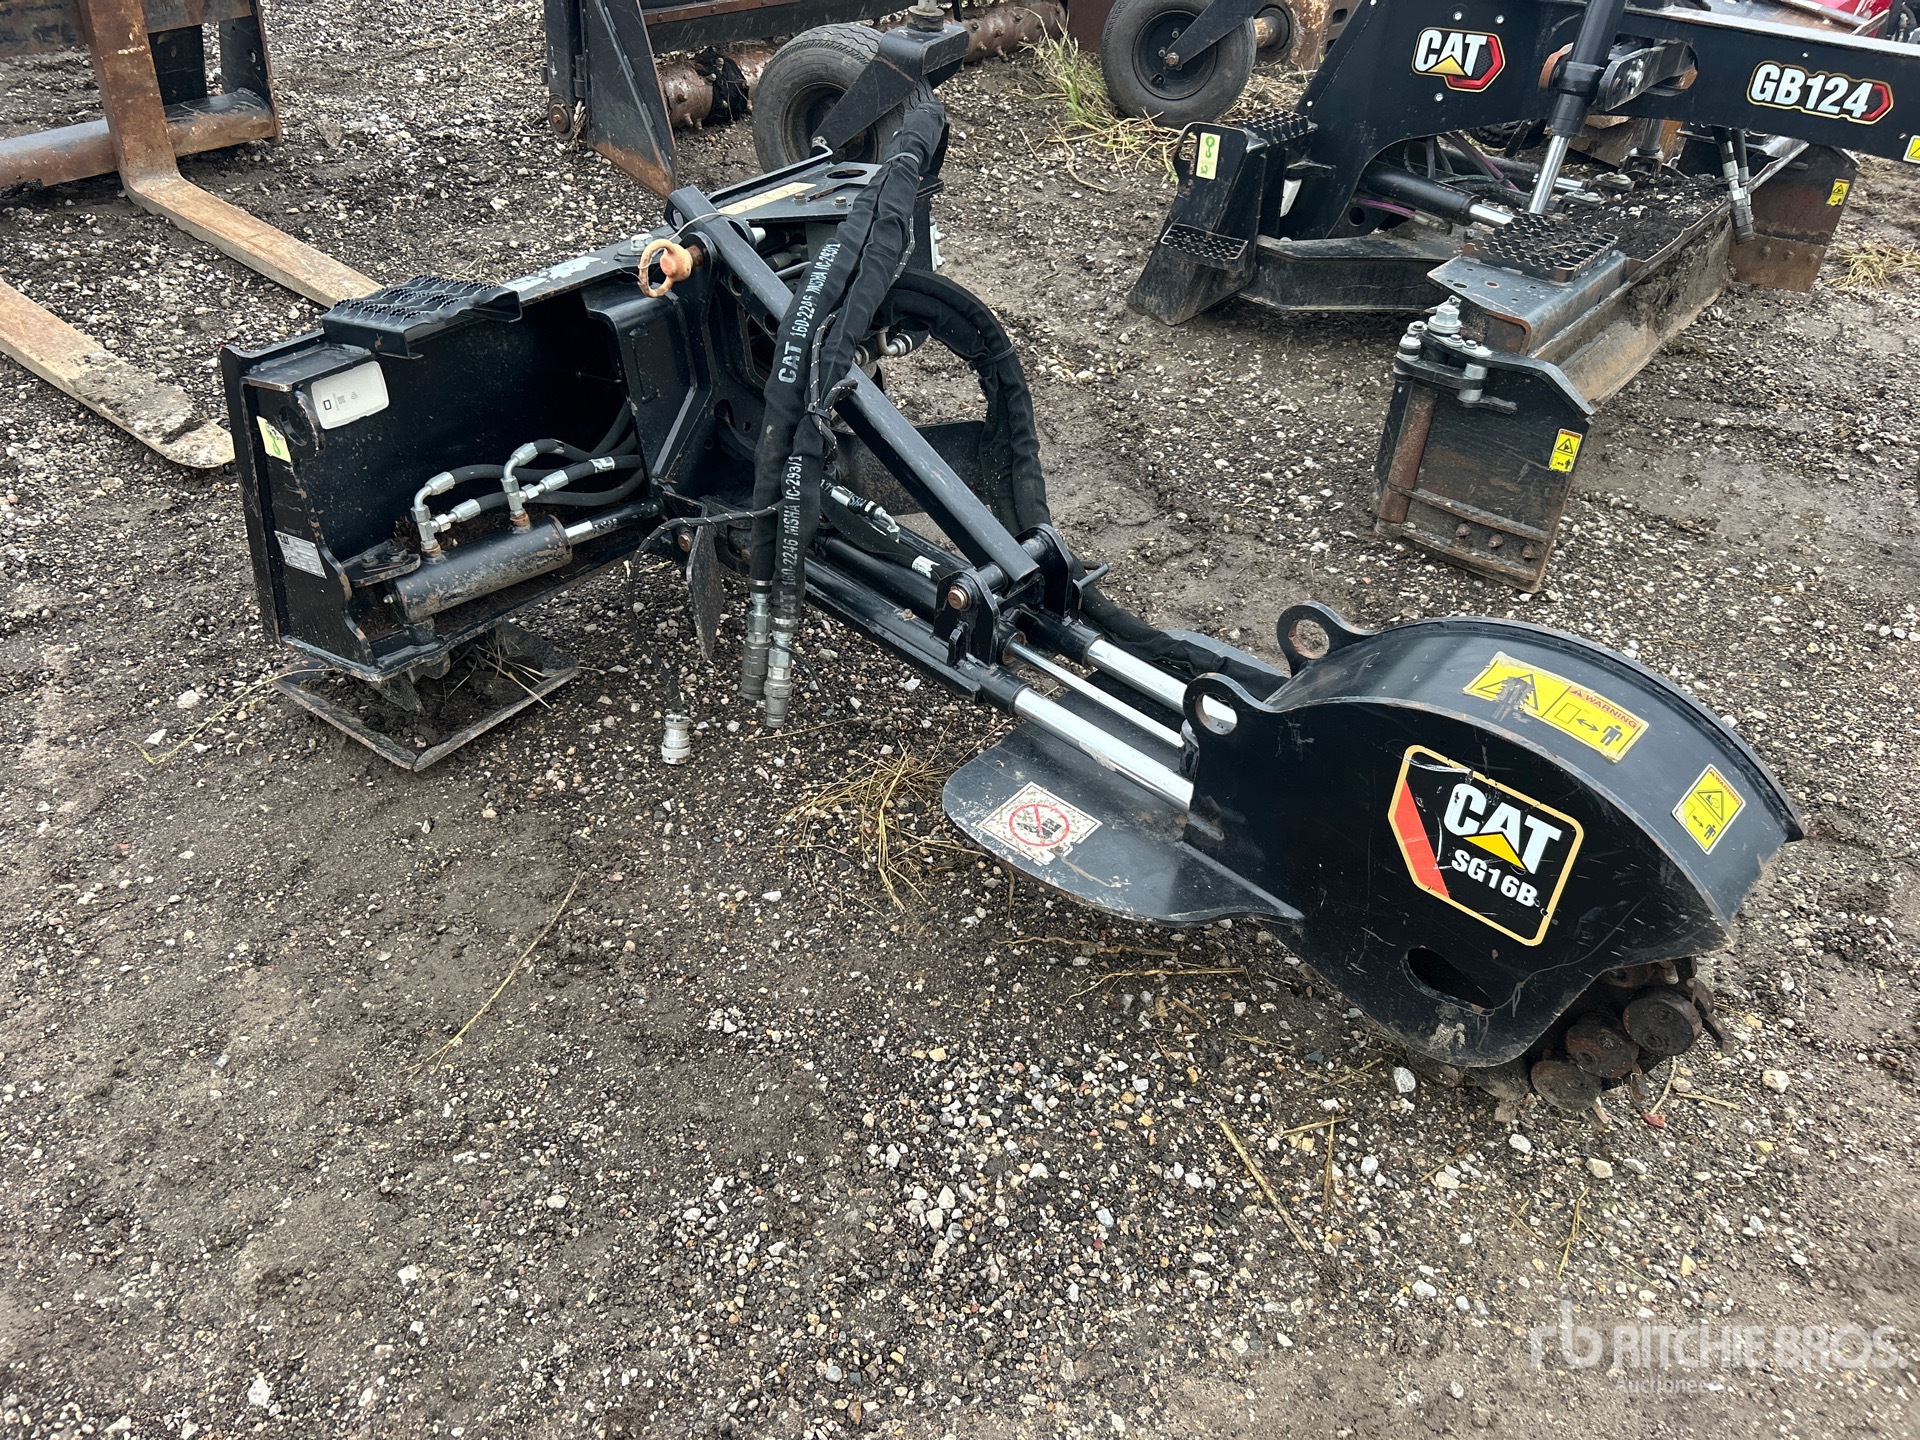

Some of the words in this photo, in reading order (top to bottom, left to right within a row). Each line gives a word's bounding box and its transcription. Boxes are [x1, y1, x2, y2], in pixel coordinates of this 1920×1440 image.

[1416, 30, 1487, 77] CAT
[1751, 63, 1872, 118] GB124
[778, 341, 802, 383] CAT
[790, 295, 817, 338] 160-2246
[805, 271, 828, 294] MSHA
[785, 455, 803, 501] IC-293/1
[784, 504, 801, 536] MSHA
[781, 539, 799, 587] 160-2246
[779, 591, 797, 619] AT
[1585, 694, 1638, 729] WARNING
[1715, 776, 1741, 806] WARNING
[1444, 783, 1562, 874] CAT
[1451, 849, 1537, 908] SG16B
